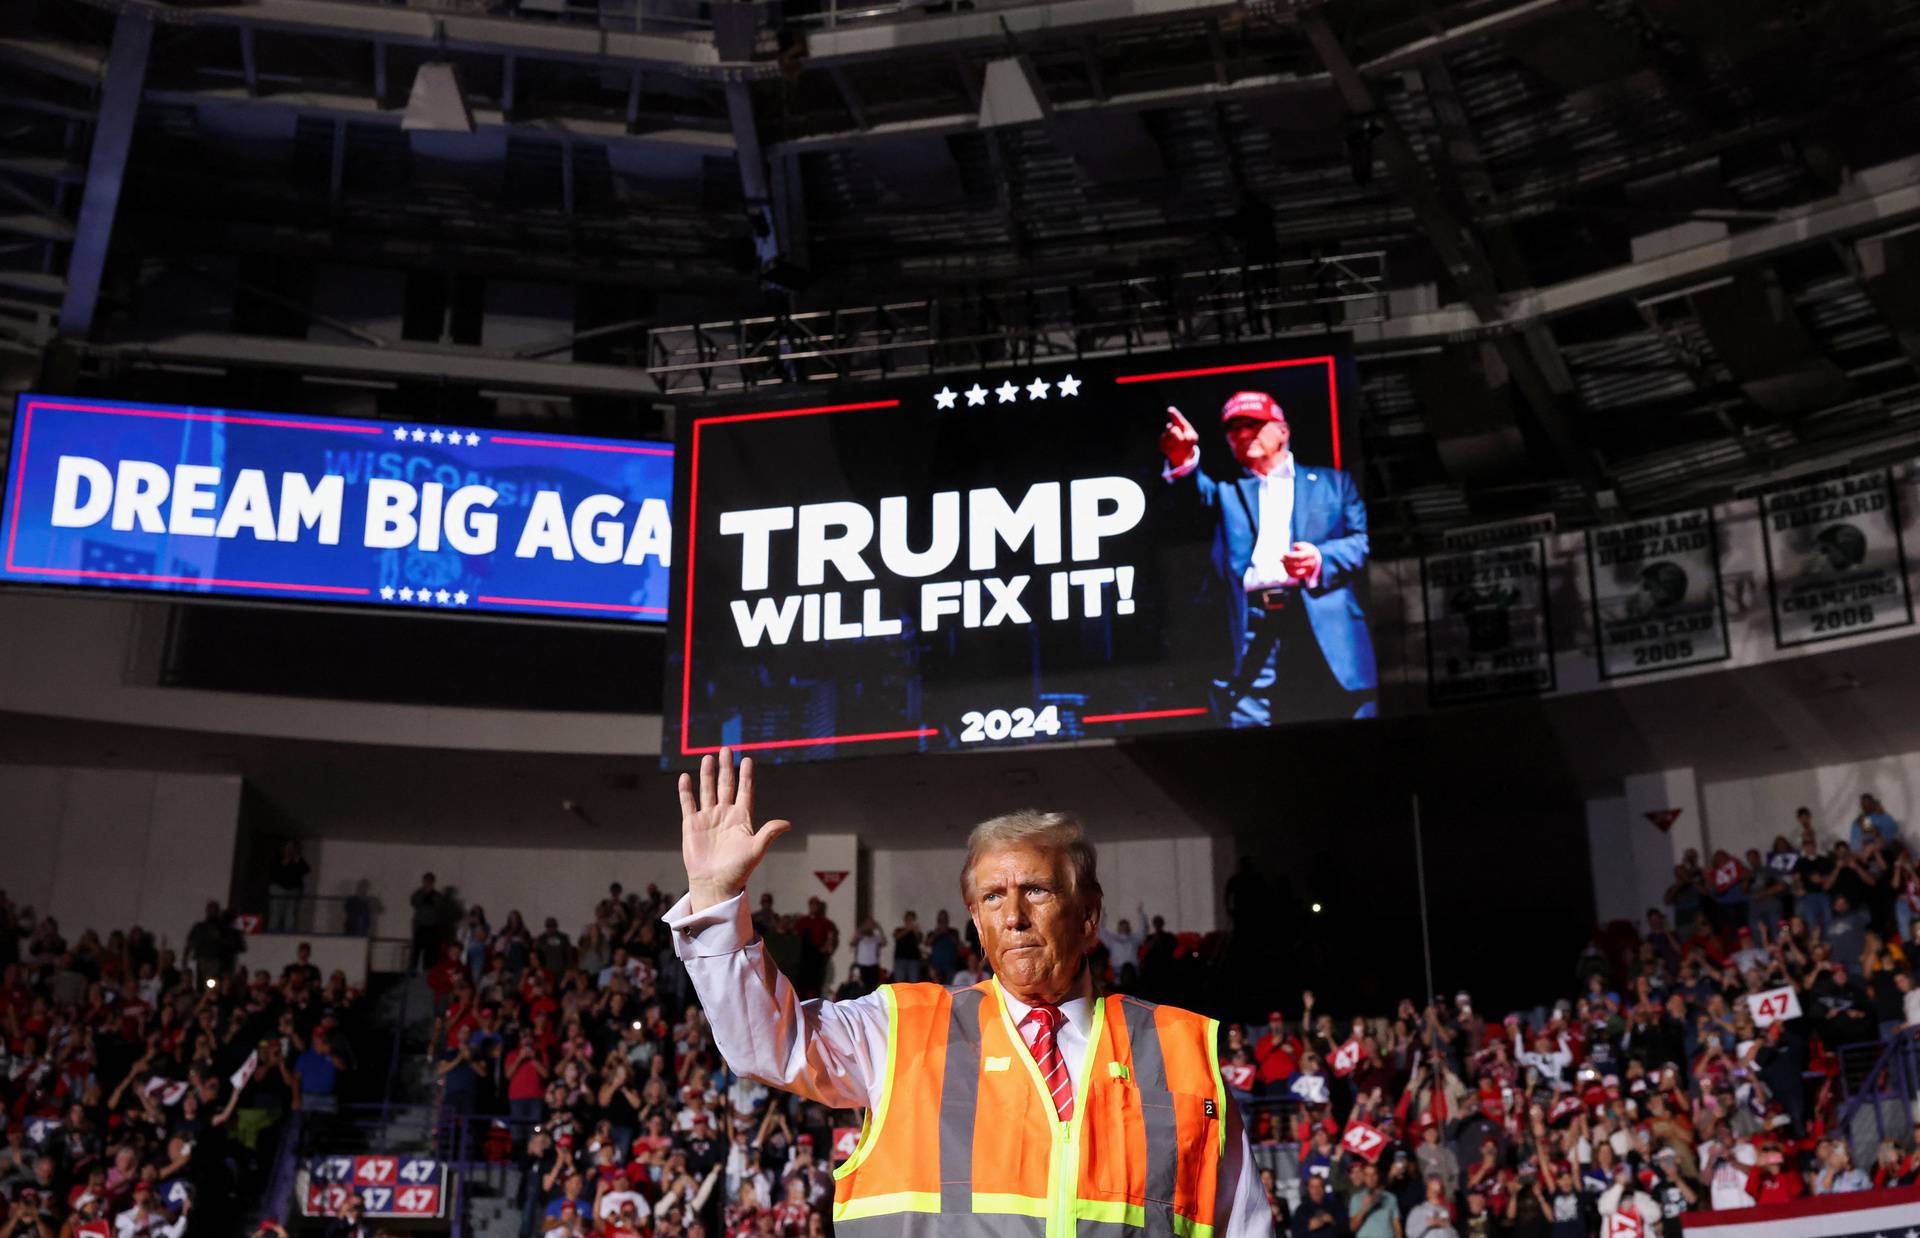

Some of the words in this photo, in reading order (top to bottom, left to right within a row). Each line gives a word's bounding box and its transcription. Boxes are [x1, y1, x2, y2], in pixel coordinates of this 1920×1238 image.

[51, 455, 345, 545] DREAM
[363, 478, 499, 556] BIG
[515, 490, 672, 568] AGA
[1773, 494, 1886, 531] BLIZZARD
[719, 476, 1146, 592] TRUMP
[729, 591, 902, 648] WILL
[921, 575, 1032, 632] FIX
[1050, 565, 1136, 621] IT!
[1633, 639, 1694, 666] 2005
[960, 705, 1061, 743] 2024
[1759, 993, 1789, 1017] 47
[1333, 1040, 1360, 1070] 47
[1205, 1104, 1213, 1115] 2
[837, 1131, 861, 1155] 4
[1344, 1126, 1383, 1151] 47
[357, 1159, 394, 1182] 47
[399, 1160, 437, 1183] 47
[397, 1187, 434, 1211] 47
